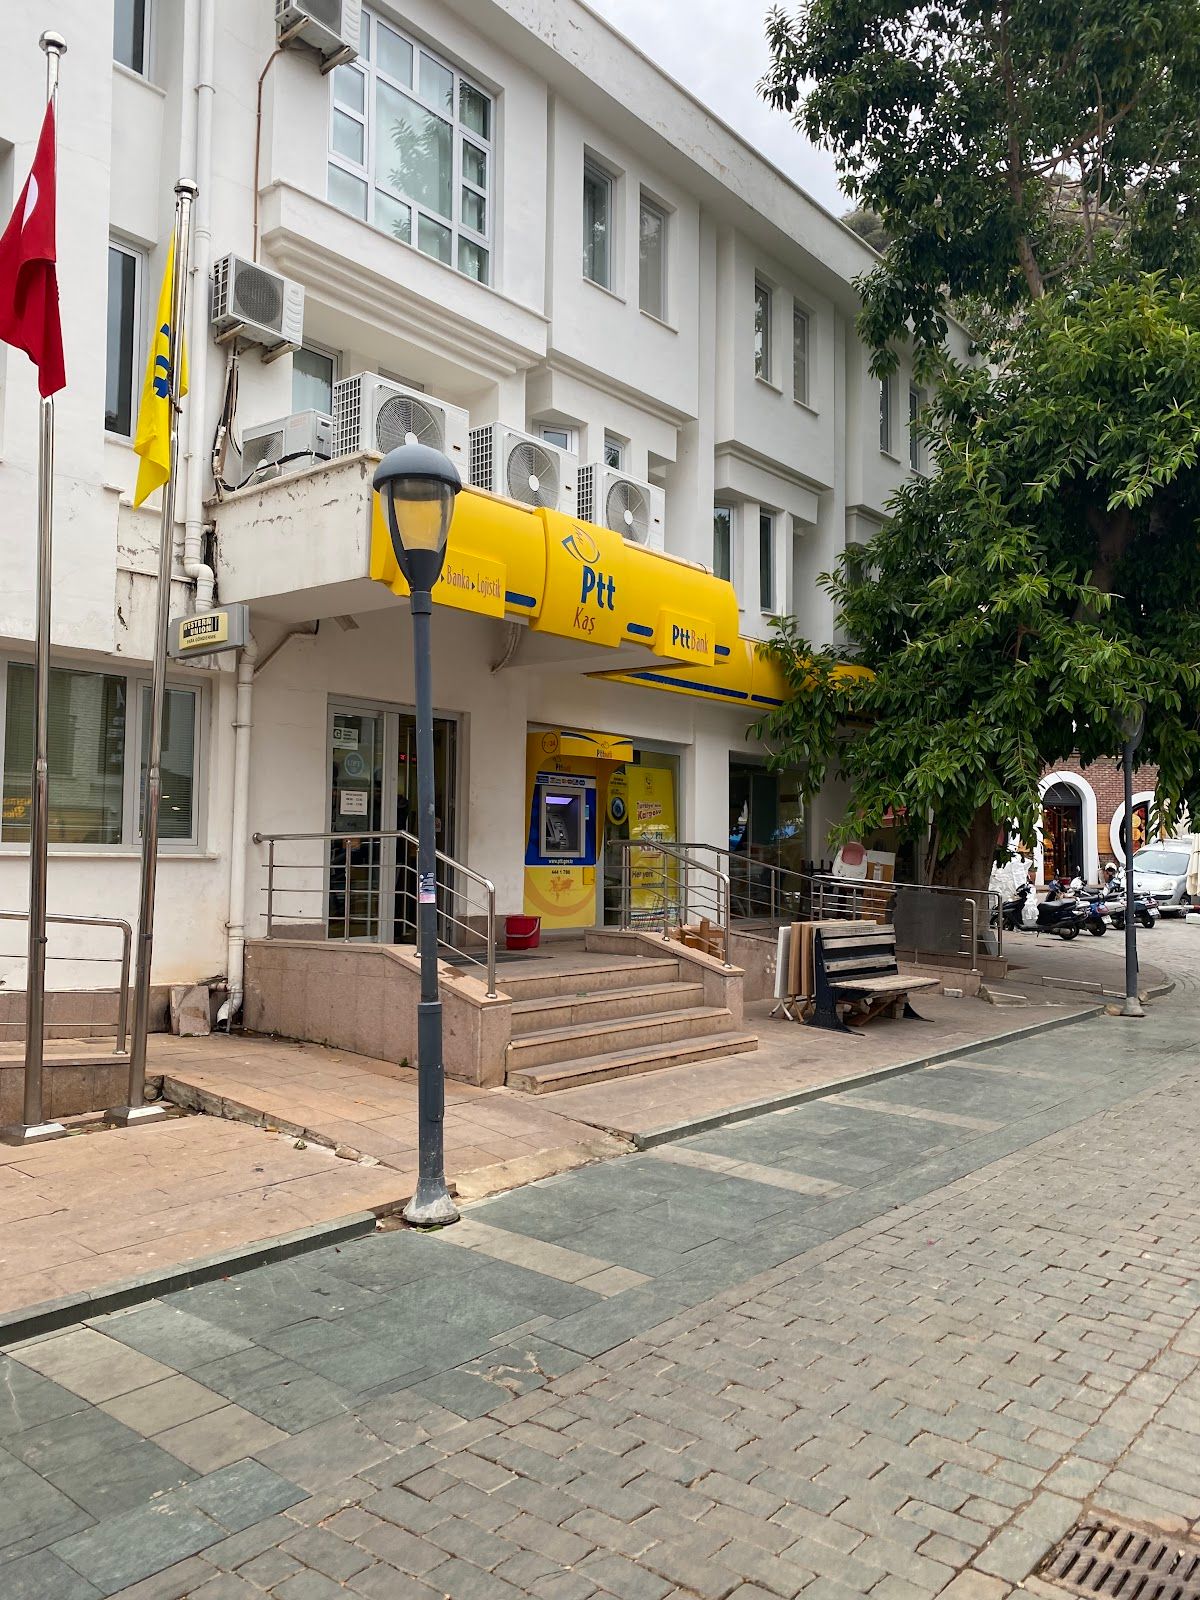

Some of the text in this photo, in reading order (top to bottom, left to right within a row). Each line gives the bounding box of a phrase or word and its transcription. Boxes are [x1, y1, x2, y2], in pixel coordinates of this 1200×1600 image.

[446, 564, 501, 598] Banka Lojistik
[580, 565, 616, 611] Ptt
[184, 618, 212, 630] WESTERN
[190, 624, 212, 636] UNION
[573, 606, 596, 635] Kaş
[672, 624, 709, 654] PttBank
